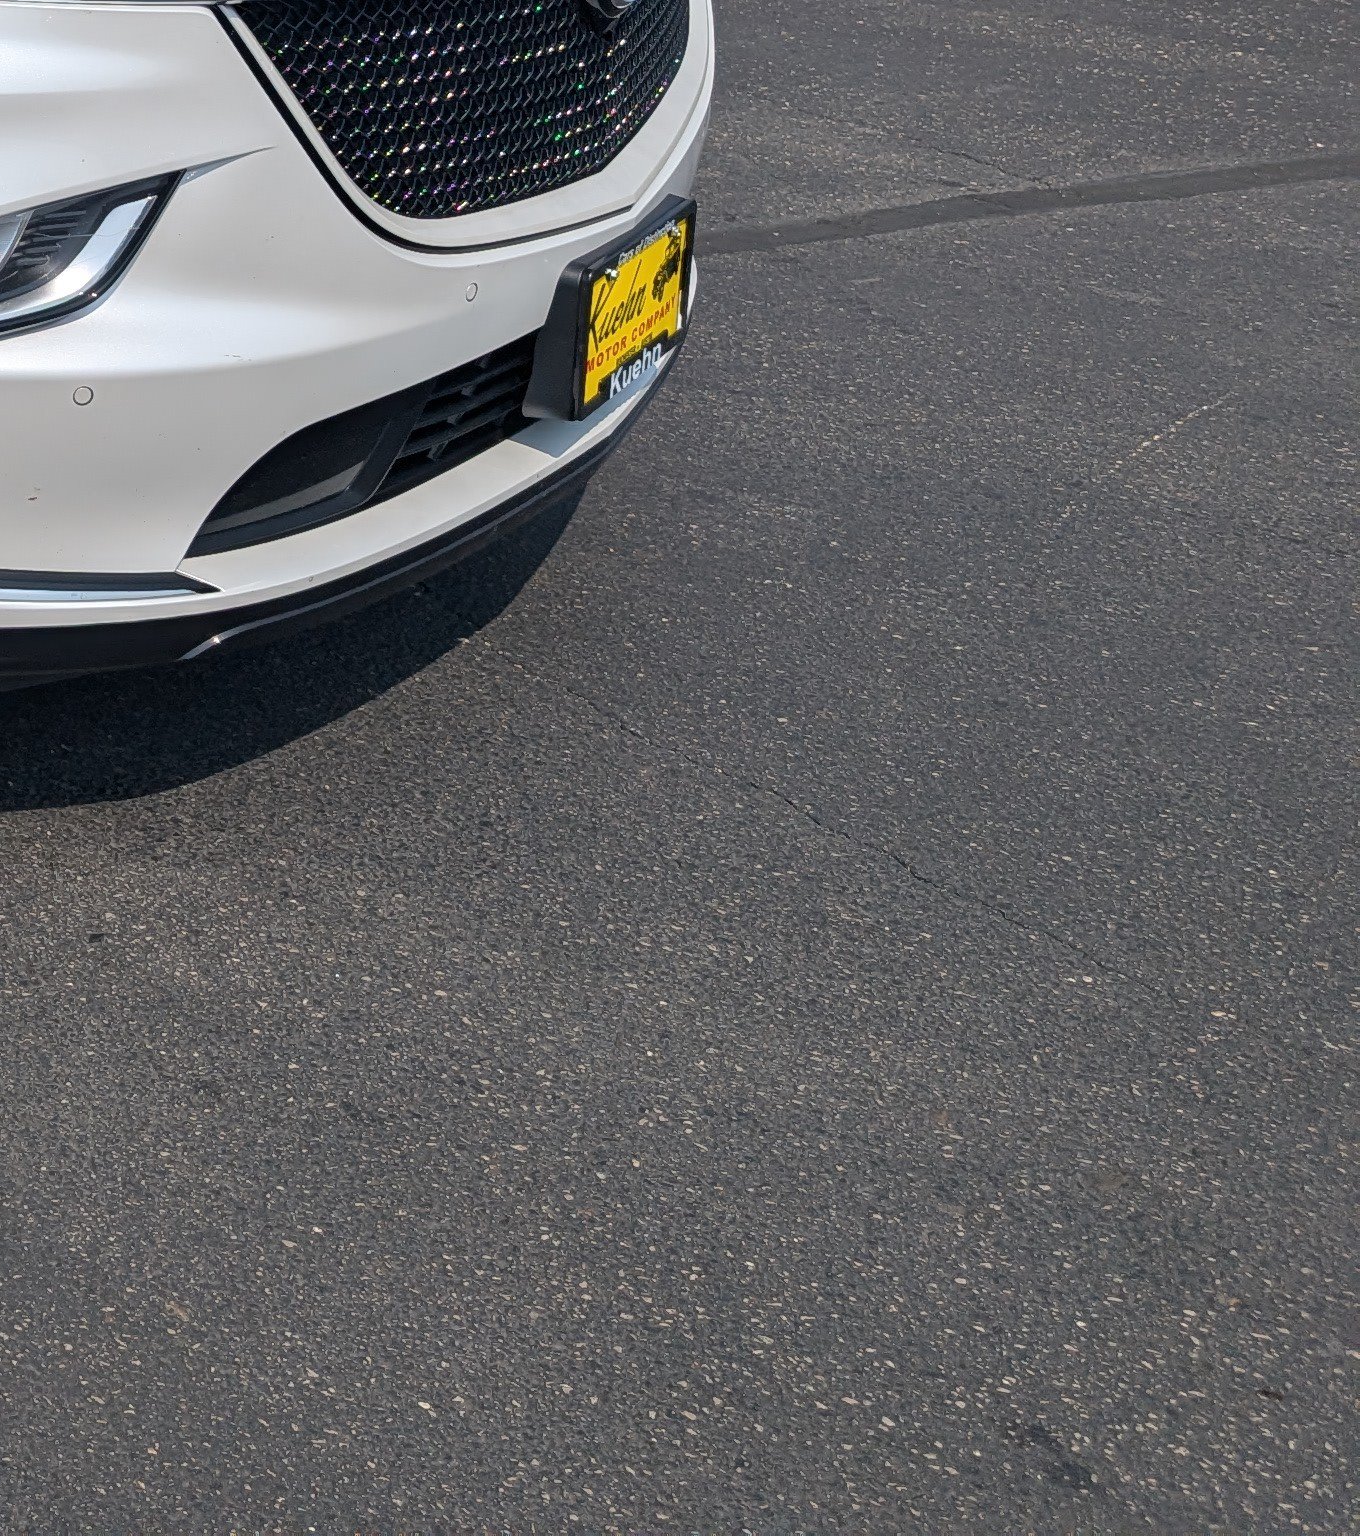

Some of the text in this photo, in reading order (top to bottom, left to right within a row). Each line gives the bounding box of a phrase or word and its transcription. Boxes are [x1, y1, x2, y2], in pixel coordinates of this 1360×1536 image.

[585, 335, 627, 372] MOTOR
[631, 293, 676, 342] COMPANY
[590, 259, 647, 353] Kuehn
[610, 342, 662, 399] Kuehn
